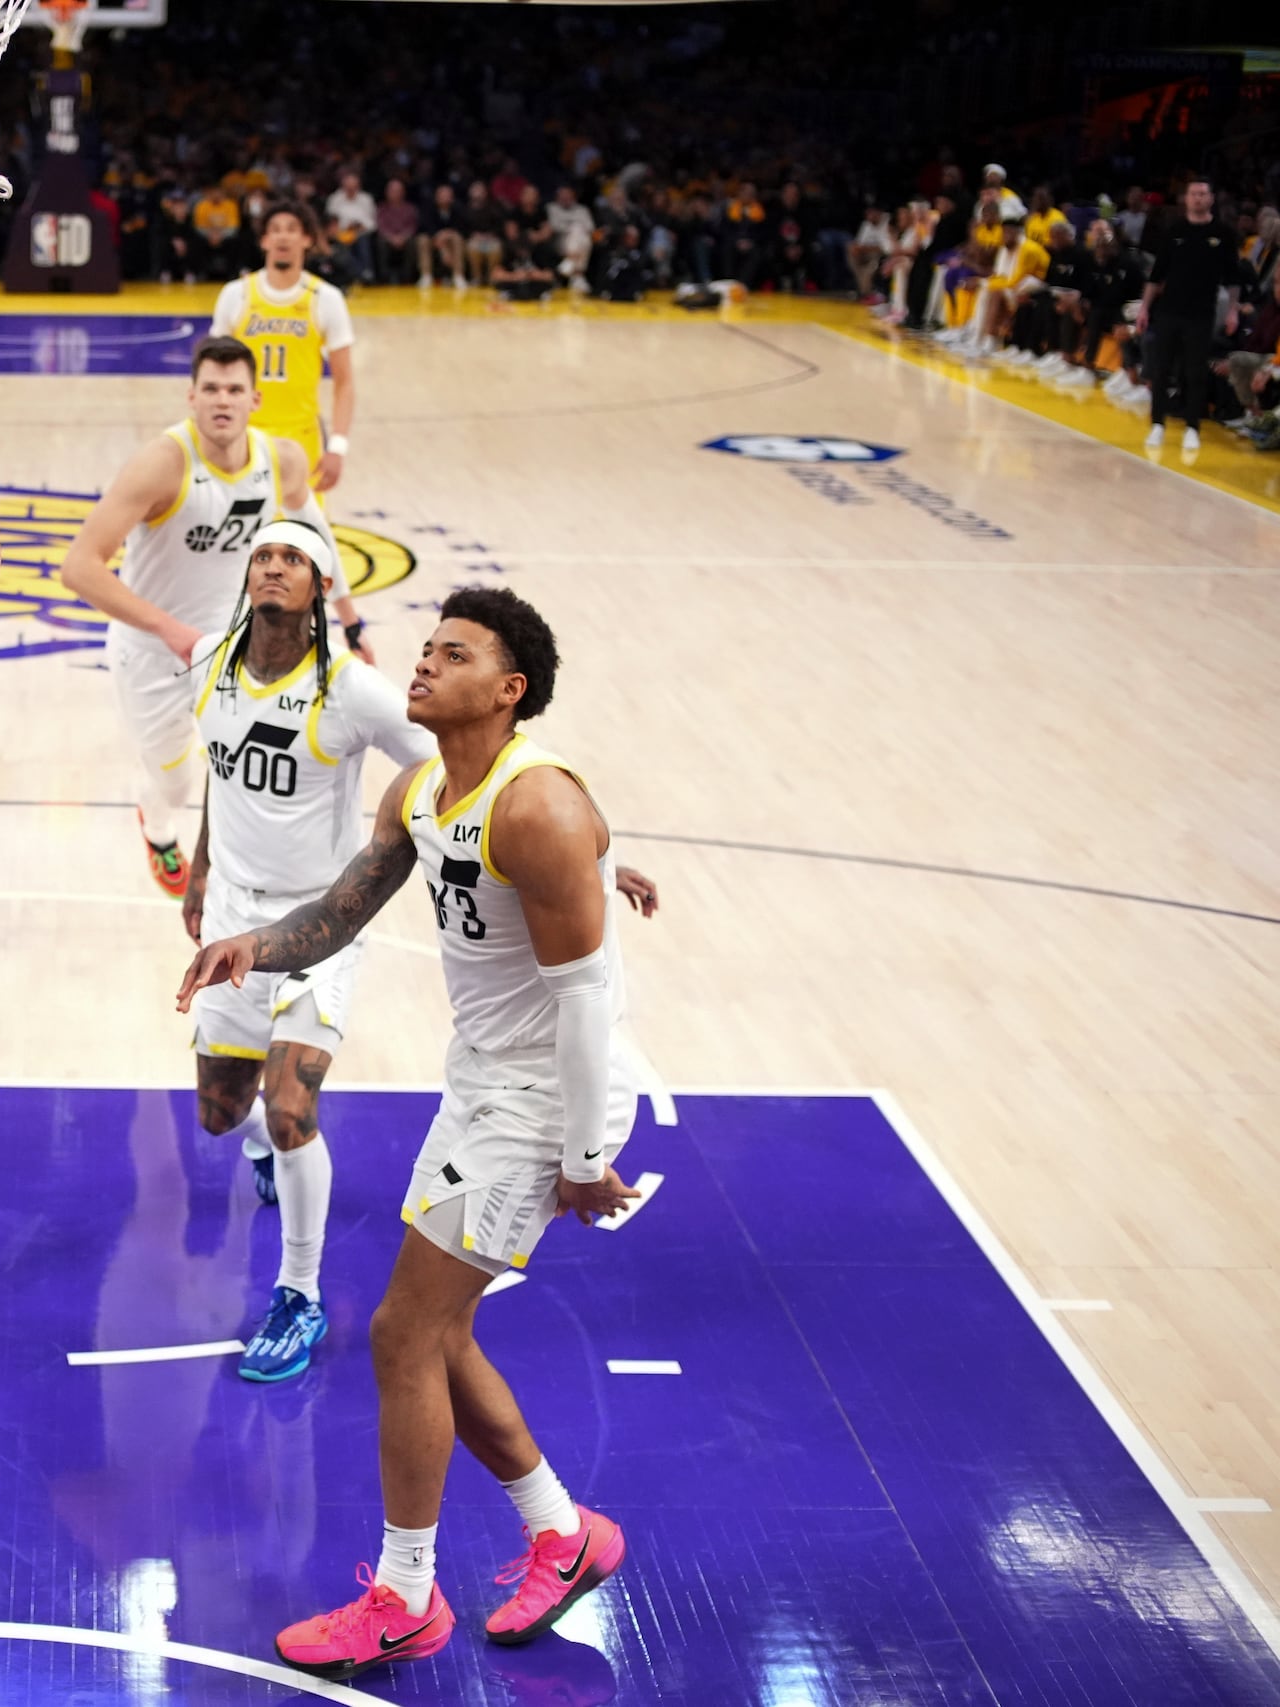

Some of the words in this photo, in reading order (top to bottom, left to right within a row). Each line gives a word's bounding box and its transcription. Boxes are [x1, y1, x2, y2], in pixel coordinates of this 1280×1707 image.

[261, 344, 287, 381] 11
[277, 694, 308, 714] LVT
[243, 745, 297, 797] 00
[452, 824, 482, 844] LVT
[455, 888, 486, 940] 3
